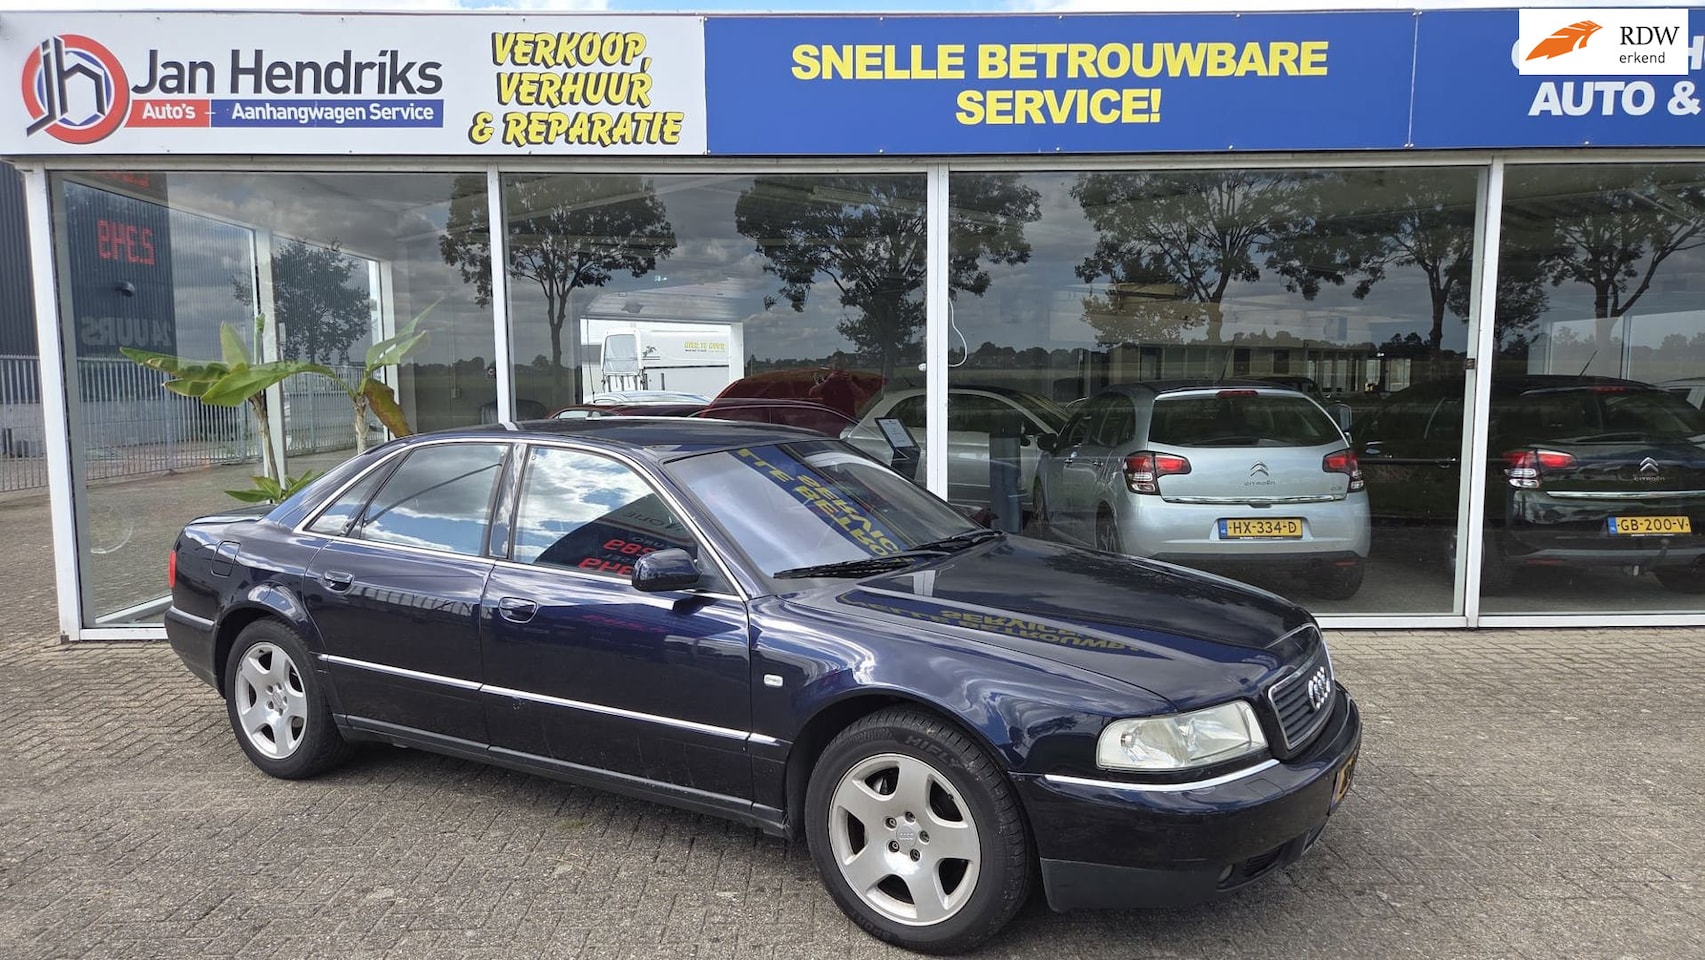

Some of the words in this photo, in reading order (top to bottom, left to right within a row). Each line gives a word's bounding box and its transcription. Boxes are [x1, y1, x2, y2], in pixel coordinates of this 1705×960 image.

[491, 32, 652, 72] VERKOOP,
[791, 44, 965, 80] SNELLE
[978, 41, 1329, 79] BETROUWBARE
[131, 49, 215, 94] Jan
[230, 49, 443, 95] Hendriks
[497, 72, 652, 108] VERHUUR
[142, 103, 196, 119] Auto's
[232, 103, 366, 124] Aanhangwagen
[369, 103, 434, 120] Service
[955, 88, 1161, 125] SERVICE!
[1528, 81, 1655, 117] AUTO
[1667, 80, 1702, 116] &
[468, 111, 494, 144] &
[502, 111, 684, 147] REPARATIE
[1233, 521, 1297, 534] HX-334-D
[1620, 518, 1685, 531] GB-200-V
